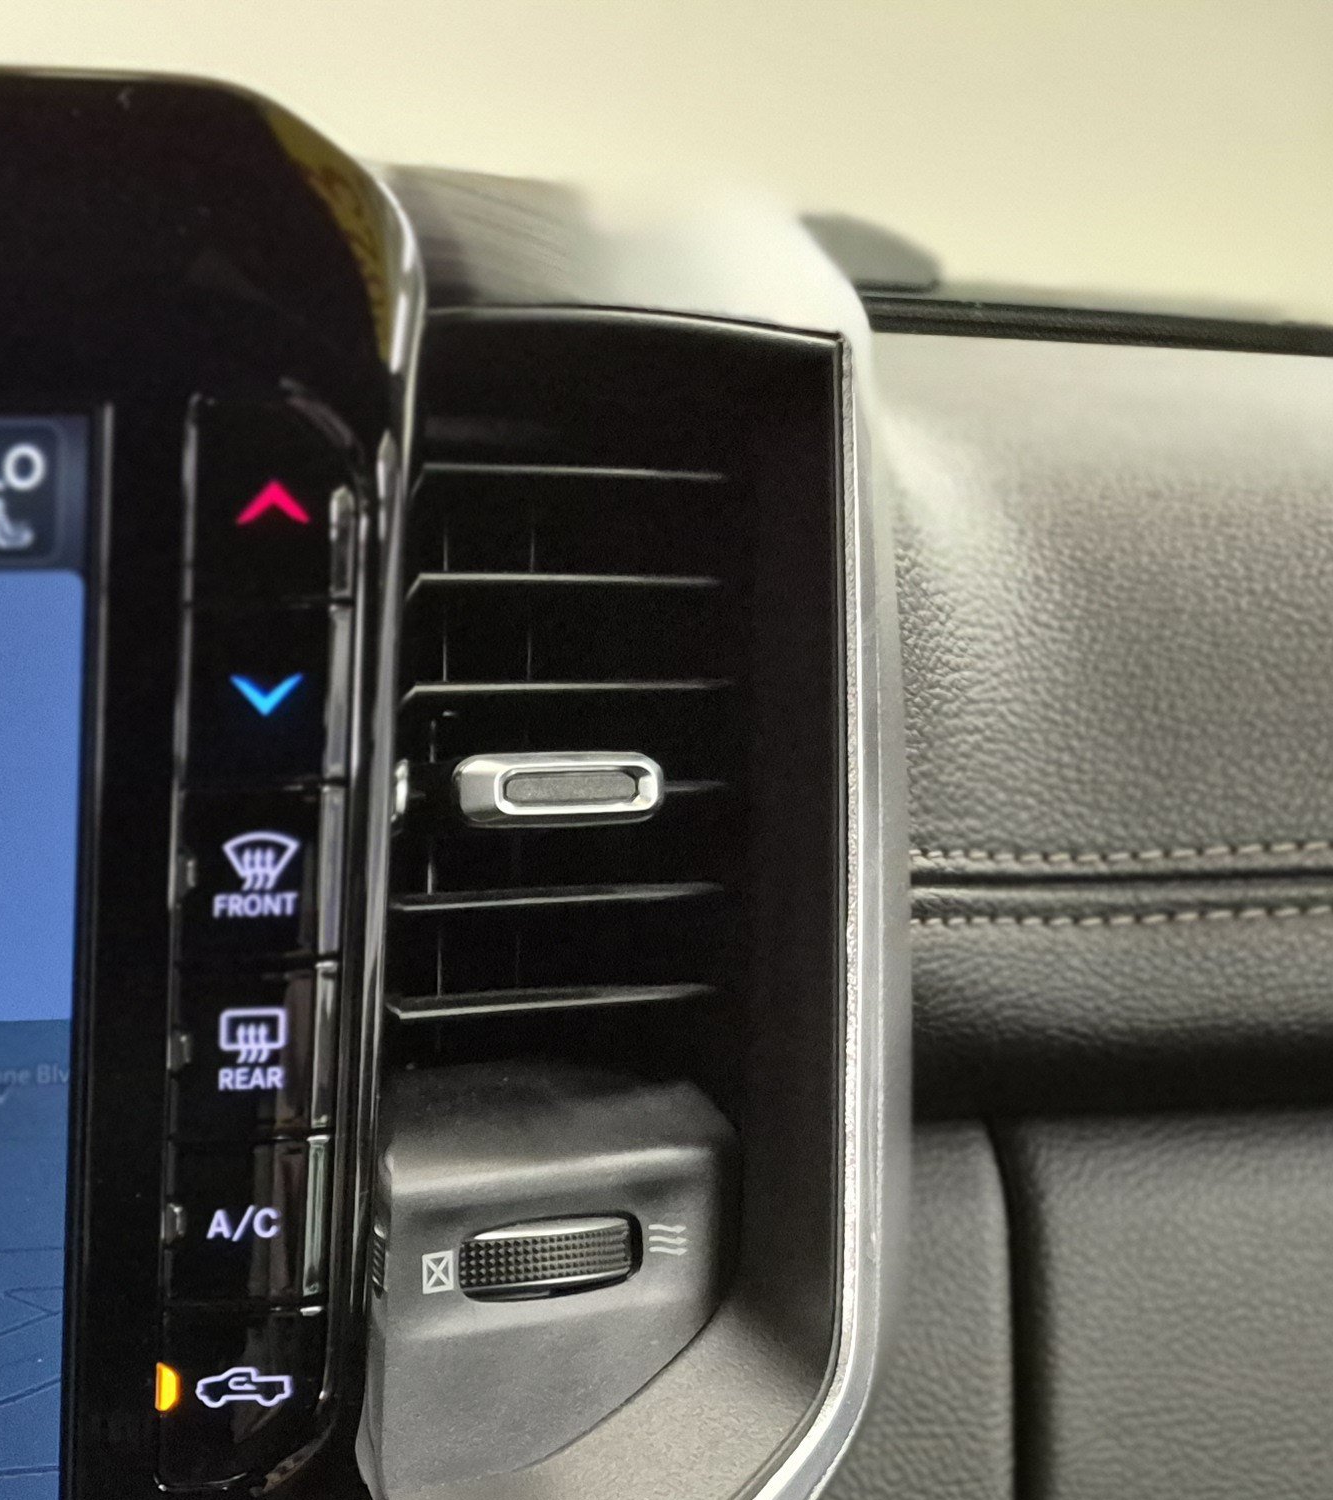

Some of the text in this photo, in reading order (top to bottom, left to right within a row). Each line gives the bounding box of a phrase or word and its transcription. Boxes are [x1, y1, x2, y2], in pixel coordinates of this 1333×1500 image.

[213, 891, 298, 918] FRONT
[219, 1066, 285, 1091] REAR
[206, 1204, 281, 1241] A/C
